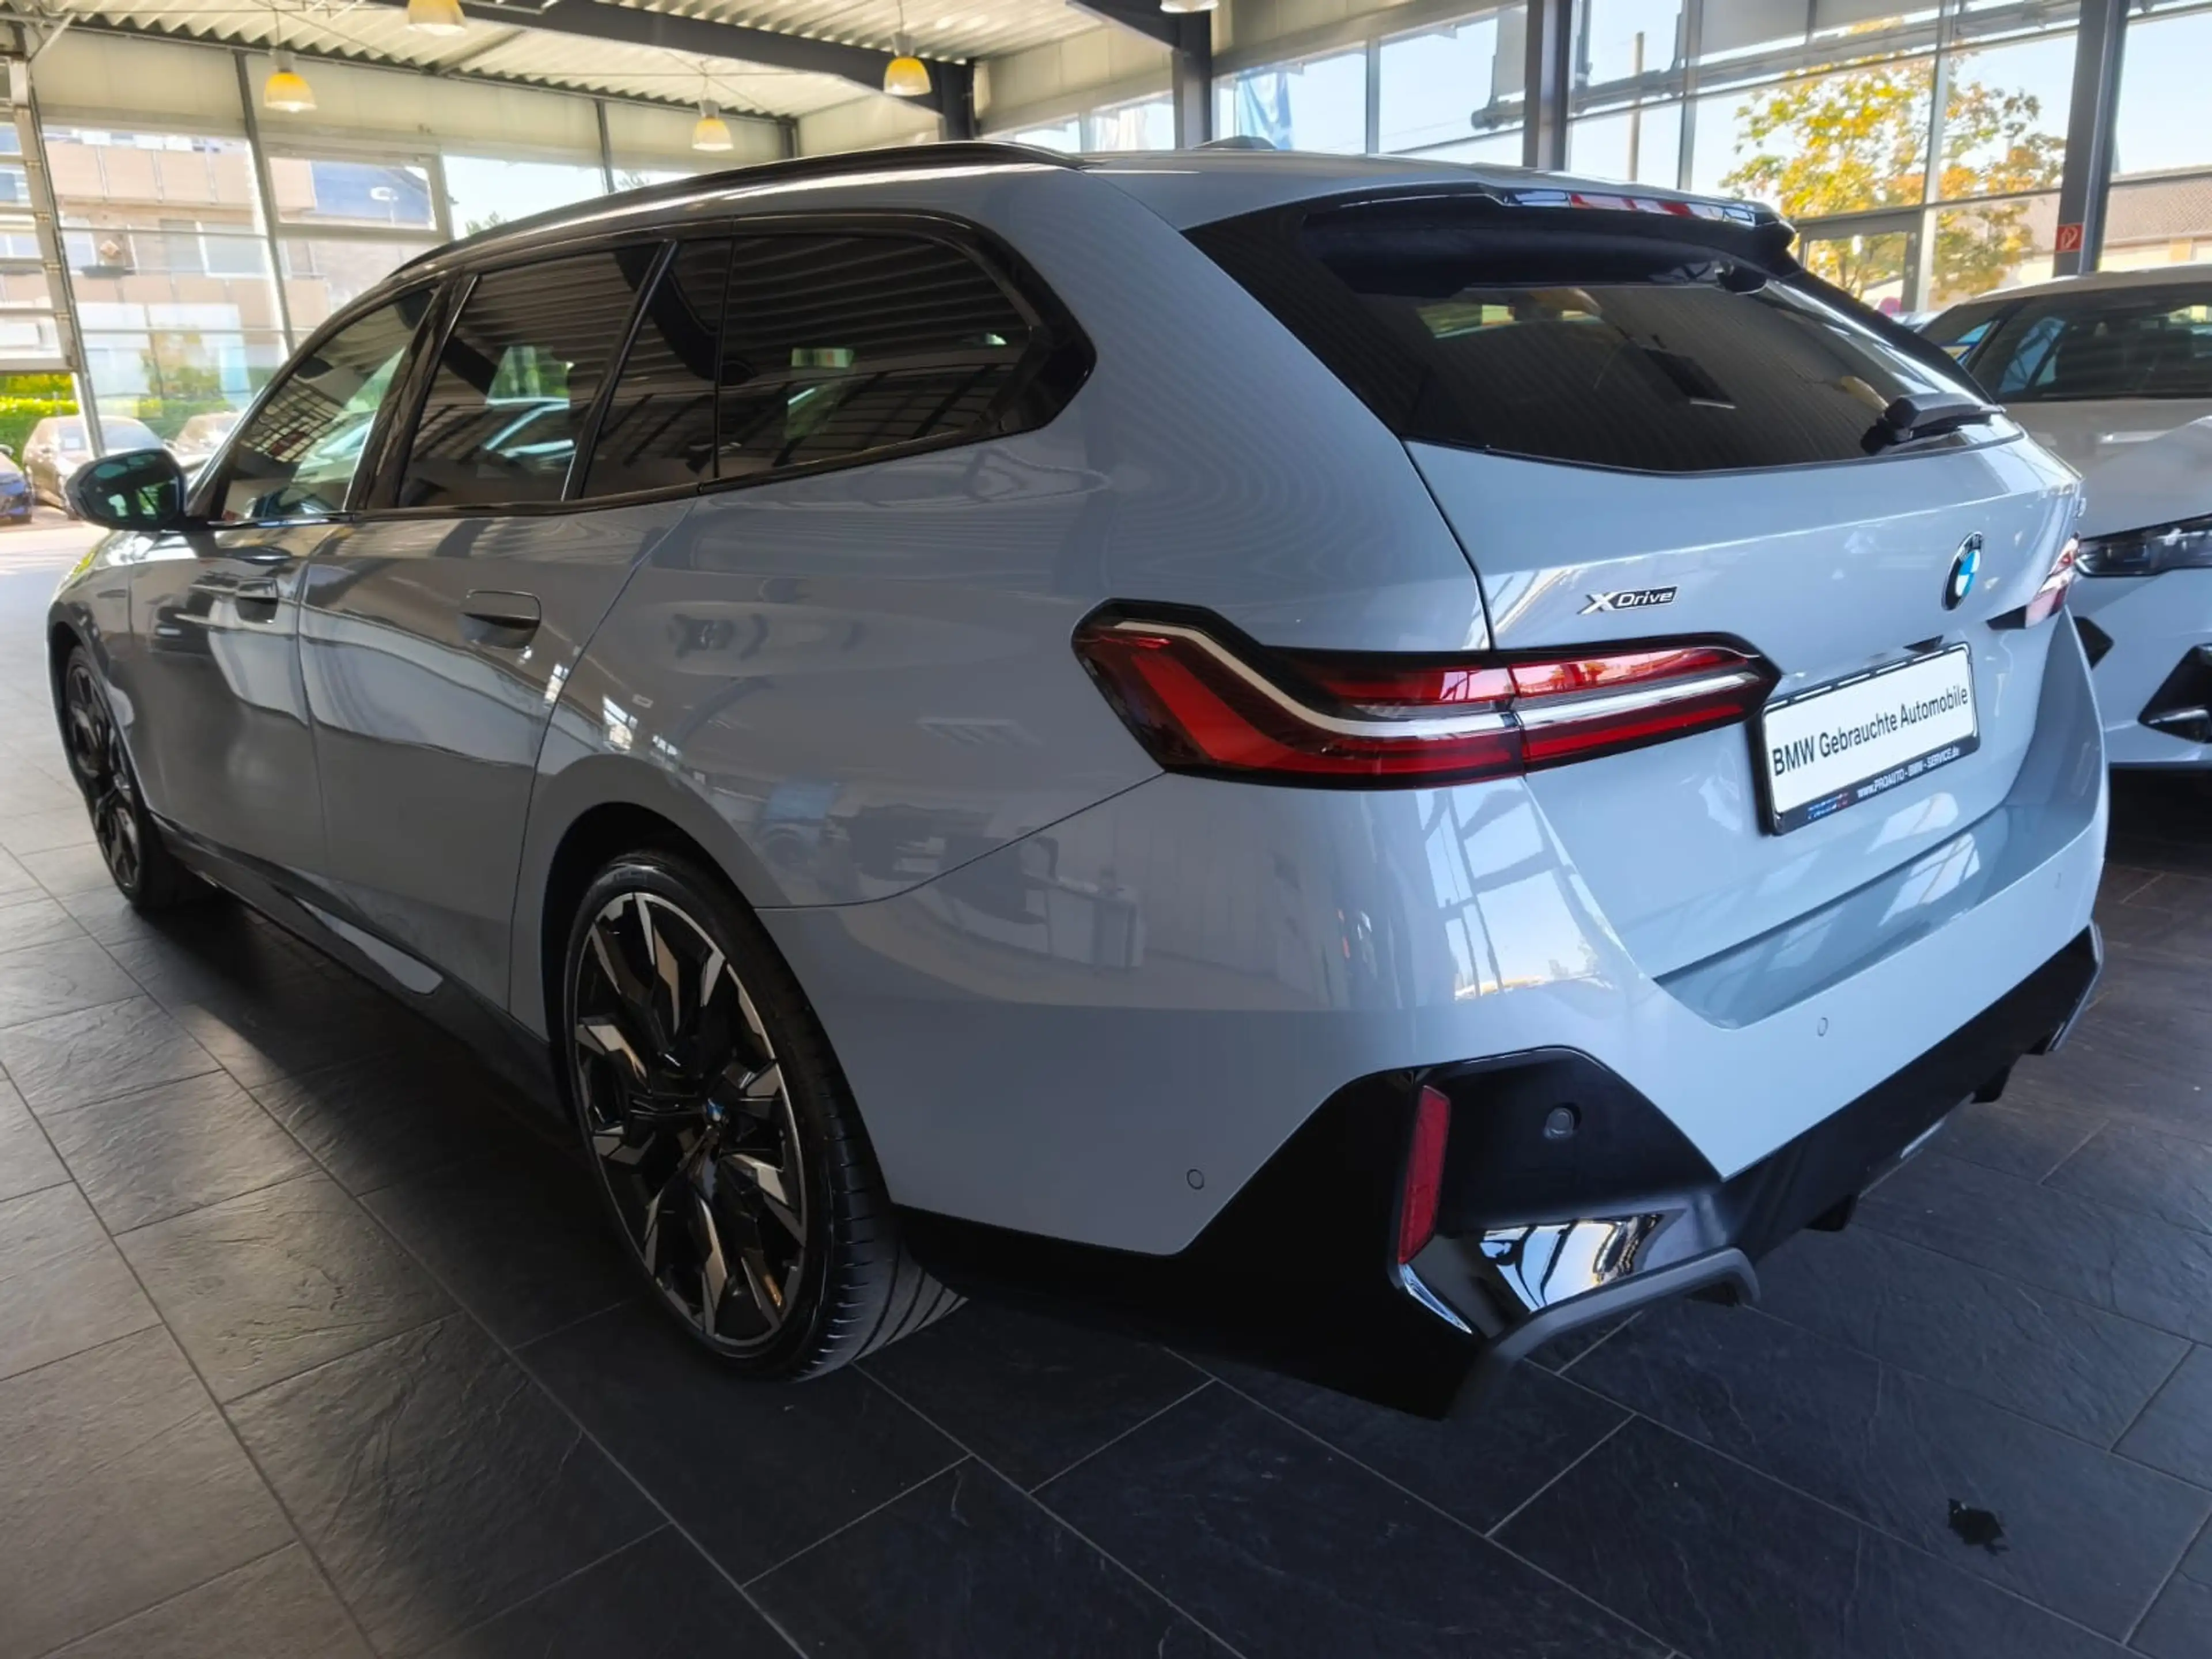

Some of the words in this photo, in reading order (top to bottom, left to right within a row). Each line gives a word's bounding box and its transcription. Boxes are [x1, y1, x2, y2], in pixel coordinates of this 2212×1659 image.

[1773, 736, 1814, 776] BMW
[1819, 713, 1897, 757] Gebrauchte
[1900, 686, 1968, 728] Automobile
